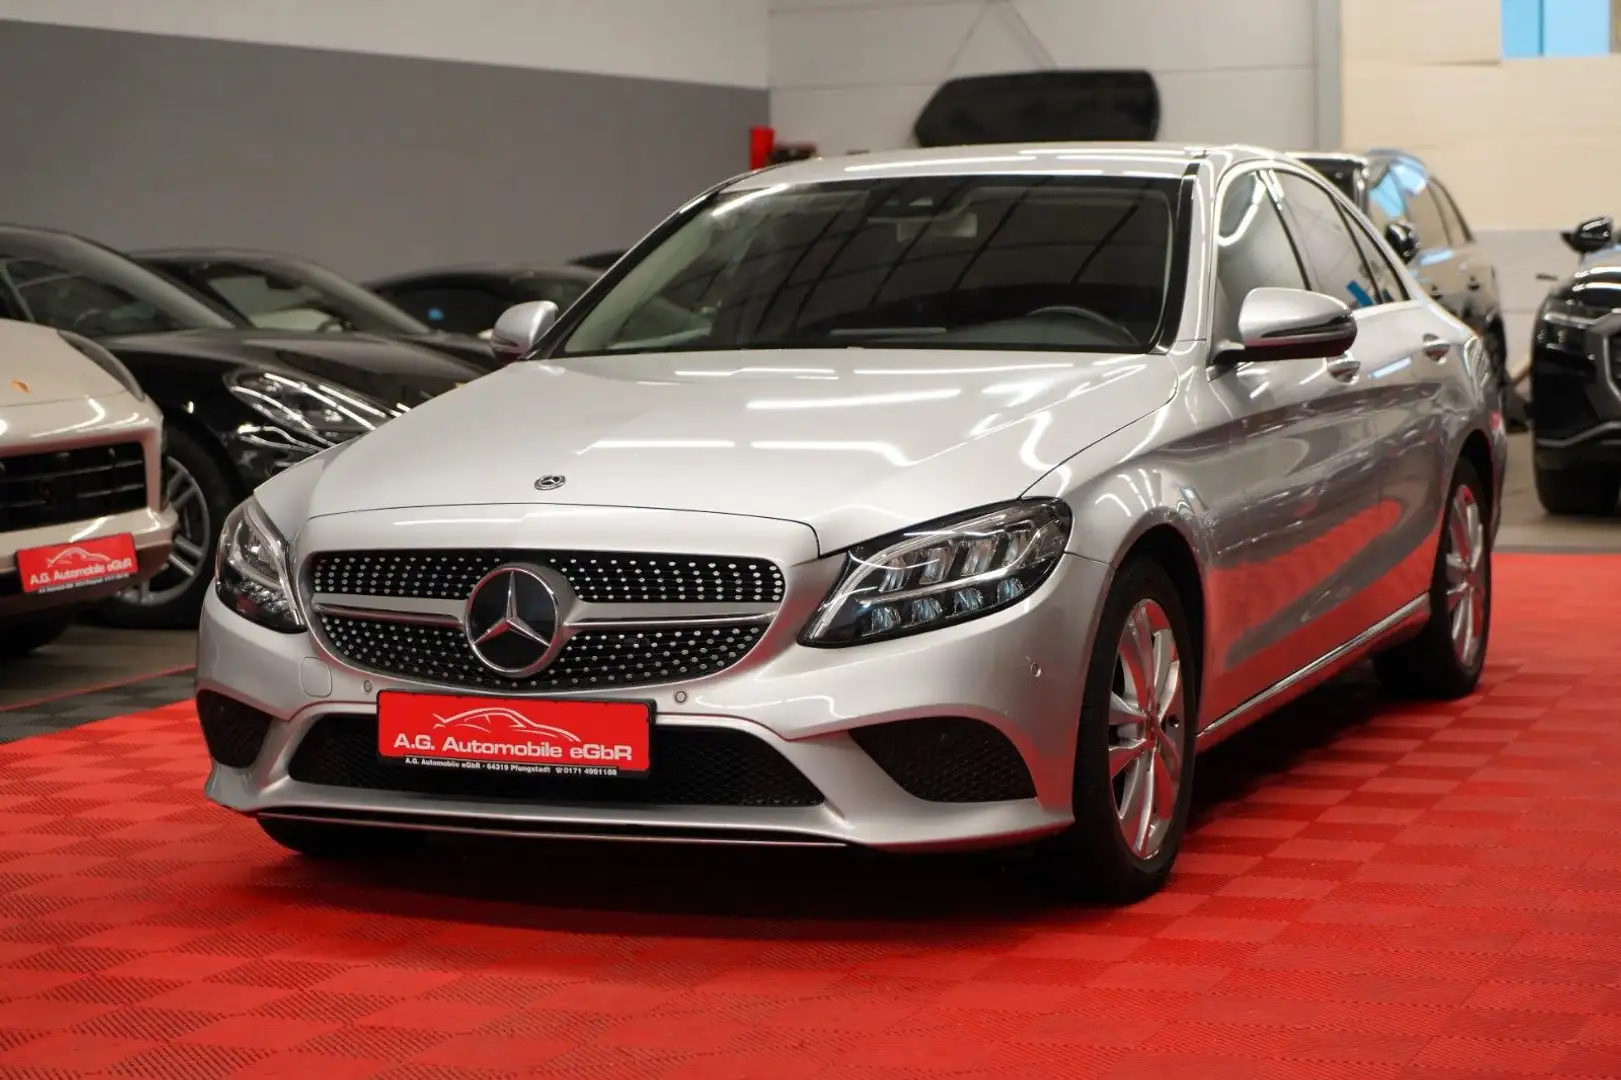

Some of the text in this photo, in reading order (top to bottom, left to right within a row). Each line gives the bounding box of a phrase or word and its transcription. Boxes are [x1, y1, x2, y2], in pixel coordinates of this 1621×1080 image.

[54, 563, 105, 580] Automobile
[393, 732, 632, 761] A.G. Automobile eGbR
[421, 758, 460, 768] Automobile
[510, 764, 551, 773] Pfungstadt
